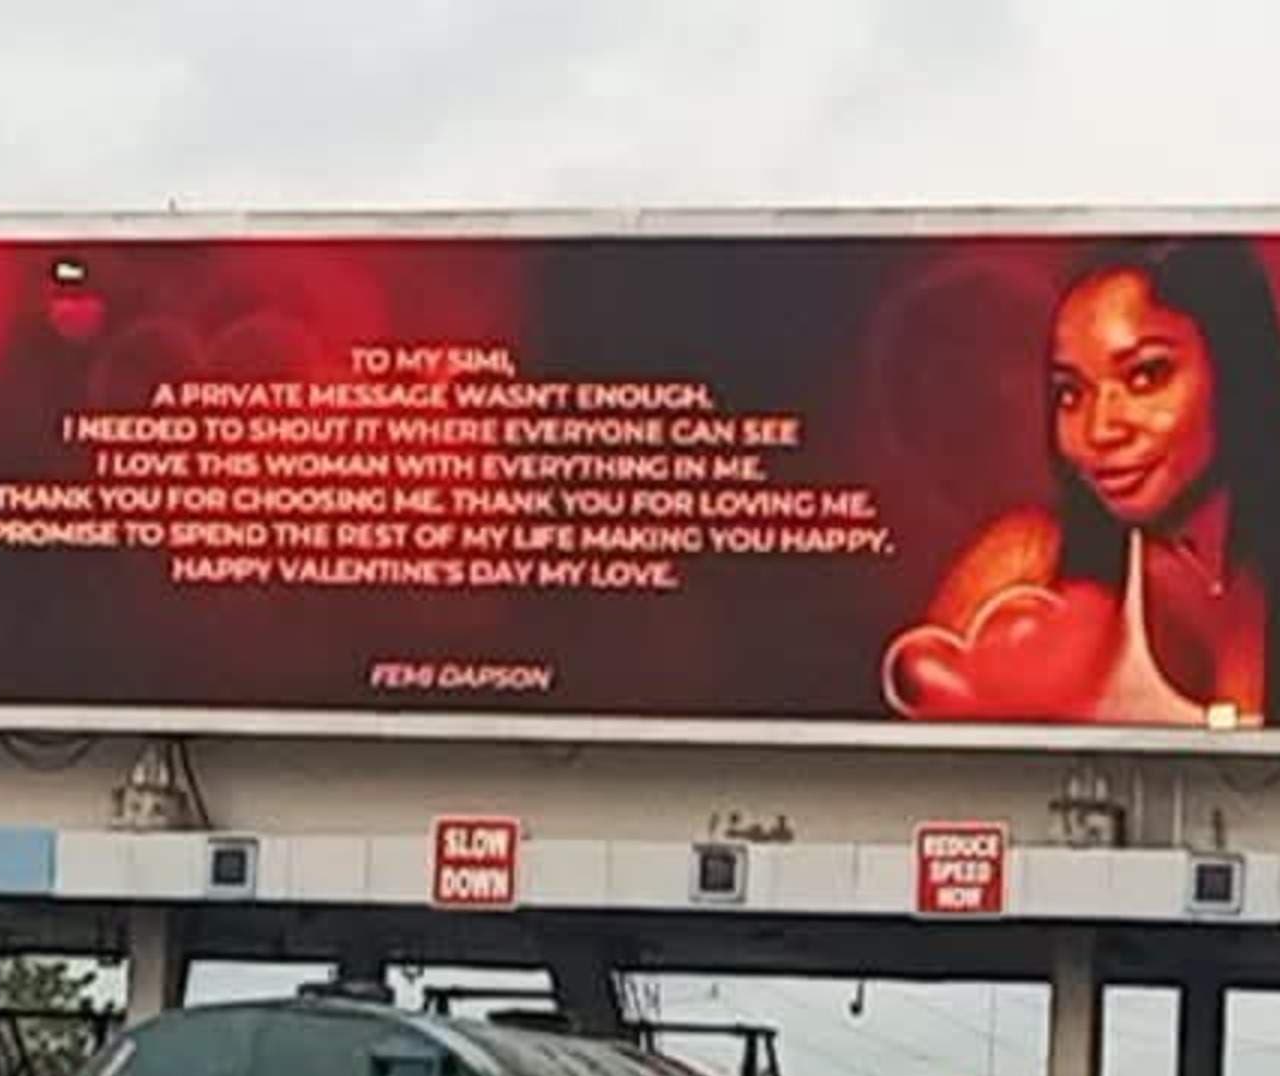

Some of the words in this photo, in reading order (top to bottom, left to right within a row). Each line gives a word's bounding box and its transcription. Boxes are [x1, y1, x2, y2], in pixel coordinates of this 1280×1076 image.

[352, 349, 390, 373] TO
[396, 349, 445, 373] MY
[447, 348, 516, 378] SIMI,
[152, 383, 177, 407] A
[181, 383, 303, 408] PRIVATE
[308, 383, 448, 408] MESSAGE
[454, 383, 572, 409] WASN'T
[576, 384, 714, 409] ENOUGH.
[62, 416, 73, 441] I
[77, 416, 198, 441] NEEDED
[203, 417, 244, 441] TO
[249, 417, 350, 442] SHOUT
[354, 418, 384, 442] IT
[387, 418, 498, 444] WHERE
[504, 419, 666, 445] EVERYONE
[670, 419, 735, 445] CAN
[742, 419, 802, 446] SEE
[97, 450, 108, 474] I
[113, 450, 189, 475] LOVE
[197, 451, 261, 475] THIS
[265, 452, 389, 477] WOMAN
[393, 453, 475, 479] WITH
[481, 454, 670, 480] EVERYTHING
[673, 455, 707, 480] IN
[713, 455, 768, 481] ME.
[98, 486, 161, 511] YOU
[167, 487, 228, 511] FOR
[231, 487, 387, 513] CHOOSING
[454, 488, 556, 514] THANK
[560, 489, 626, 515] YOU
[630, 490, 693, 515] FOR
[699, 490, 817, 517] LOVING
[822, 491, 878, 518] ME.
[124, 522, 165, 546] TO
[168, 523, 268, 547] SPEND
[273, 524, 330, 548] THE
[335, 525, 409, 549] REST
[414, 525, 453, 549] OF
[461, 526, 510, 550] MY
[514, 527, 577, 551] LIFE
[580, 527, 703, 552] MAKING
[708, 528, 774, 553] YOU
[779, 529, 896, 556] HAPPY.
[172, 557, 276, 582] HAPPY
[279, 558, 469, 585] VALENTINE'S
[470, 560, 536, 585] DAY
[538, 561, 588, 586] MY
[591, 562, 680, 588] LOVE.
[443, 827, 510, 861] SLOW
[923, 833, 999, 859] REDUCE
[438, 866, 508, 899] DOWN
[929, 859, 991, 885] SPEED
